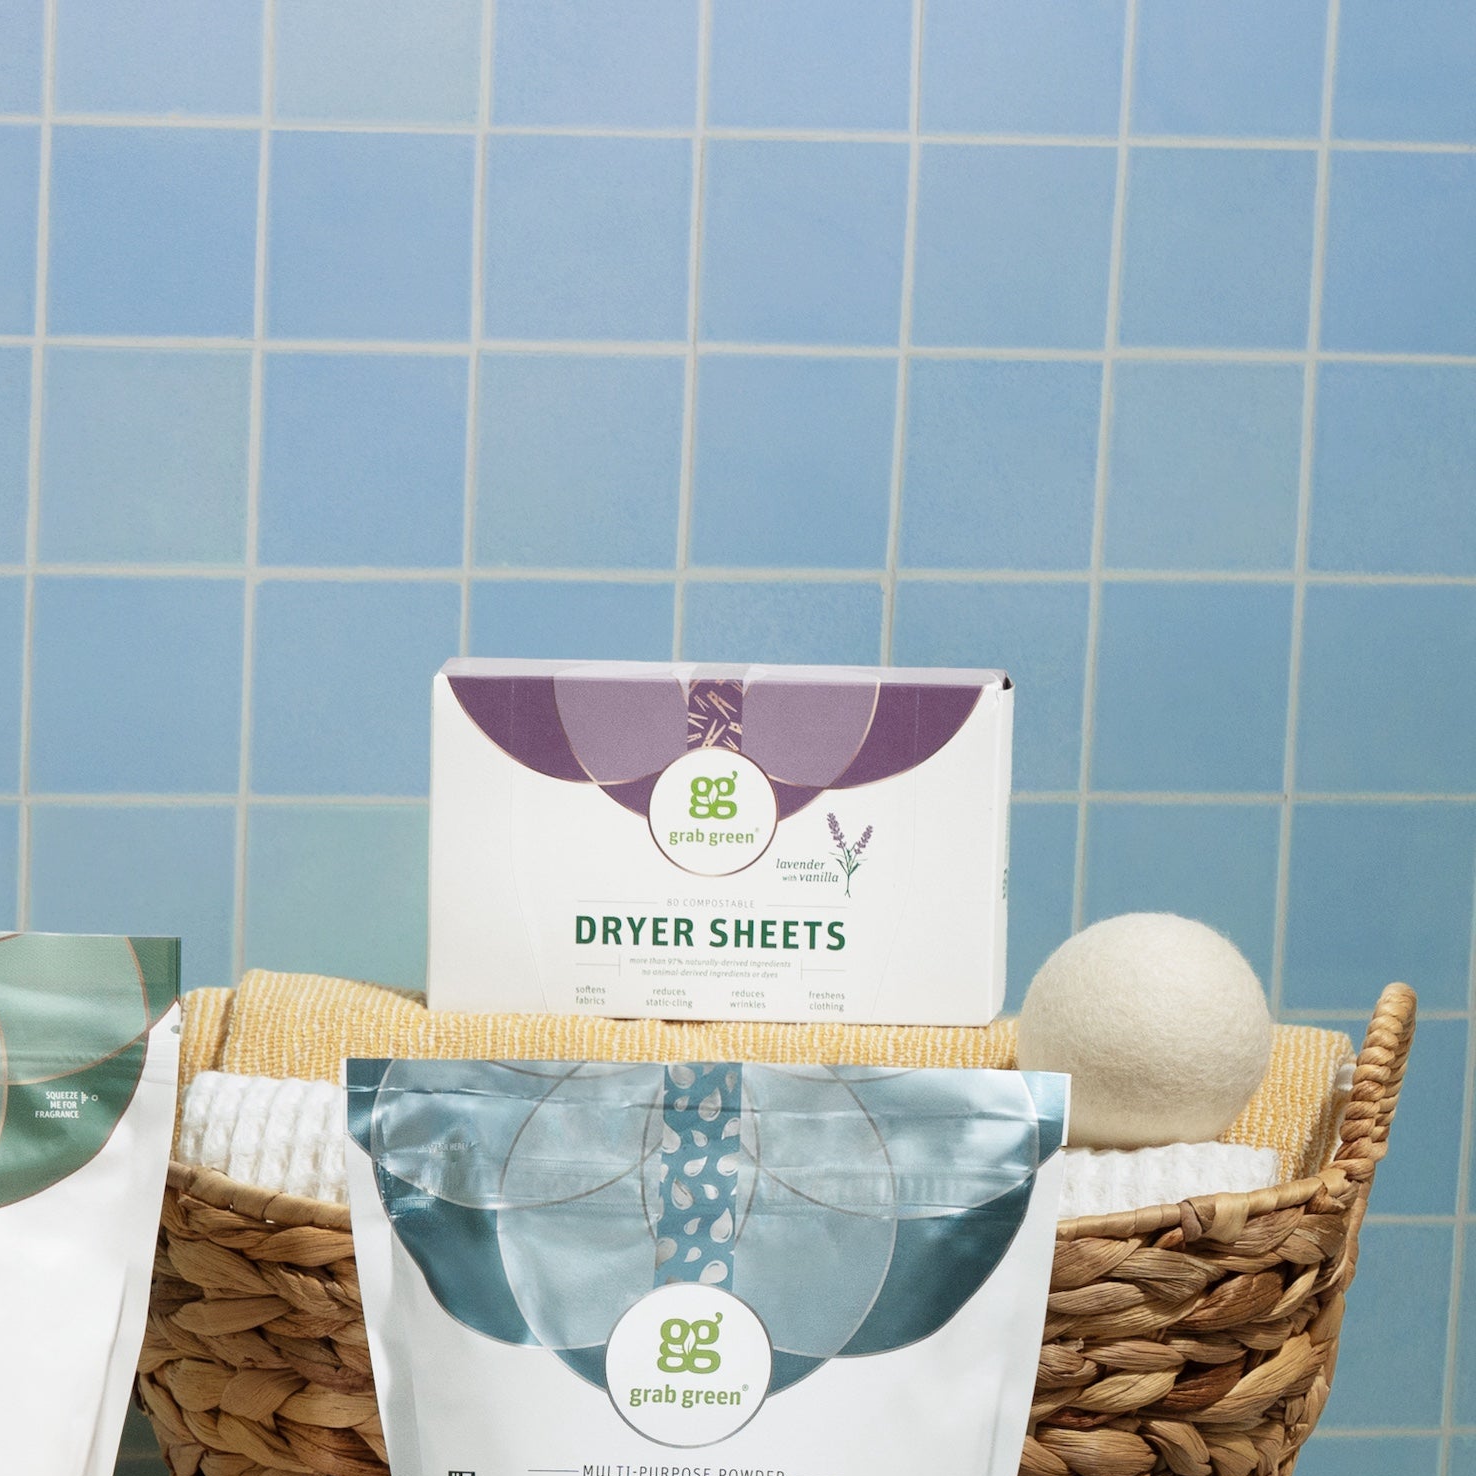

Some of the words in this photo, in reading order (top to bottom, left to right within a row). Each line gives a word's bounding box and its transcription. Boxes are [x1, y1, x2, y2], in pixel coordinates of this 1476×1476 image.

[669, 827, 705, 846] grab
[776, 858, 825, 870] lavender
[800, 872, 839, 882] vanilla
[666, 898, 679, 906] 80
[682, 899, 755, 908] COMPOSTABLE
[576, 916, 693, 946] DRYER
[709, 918, 845, 950] SHEETS
[575, 985, 606, 994] softens
[652, 986, 686, 996] reduces
[731, 989, 765, 998] reduces
[808, 990, 846, 1000] freshens
[575, 996, 606, 1005] fabrics
[645, 997, 693, 1008] static-cling
[729, 999, 766, 1008] wrinkles
[809, 1001, 845, 1012] clothing
[46, 1091, 78, 1099] SQUEEZE
[50, 1101, 61, 1109] ME
[63, 1101, 77, 1109] FOR
[35, 1110, 79, 1118] FRAGRANCE
[629, 1384, 676, 1409] grab
